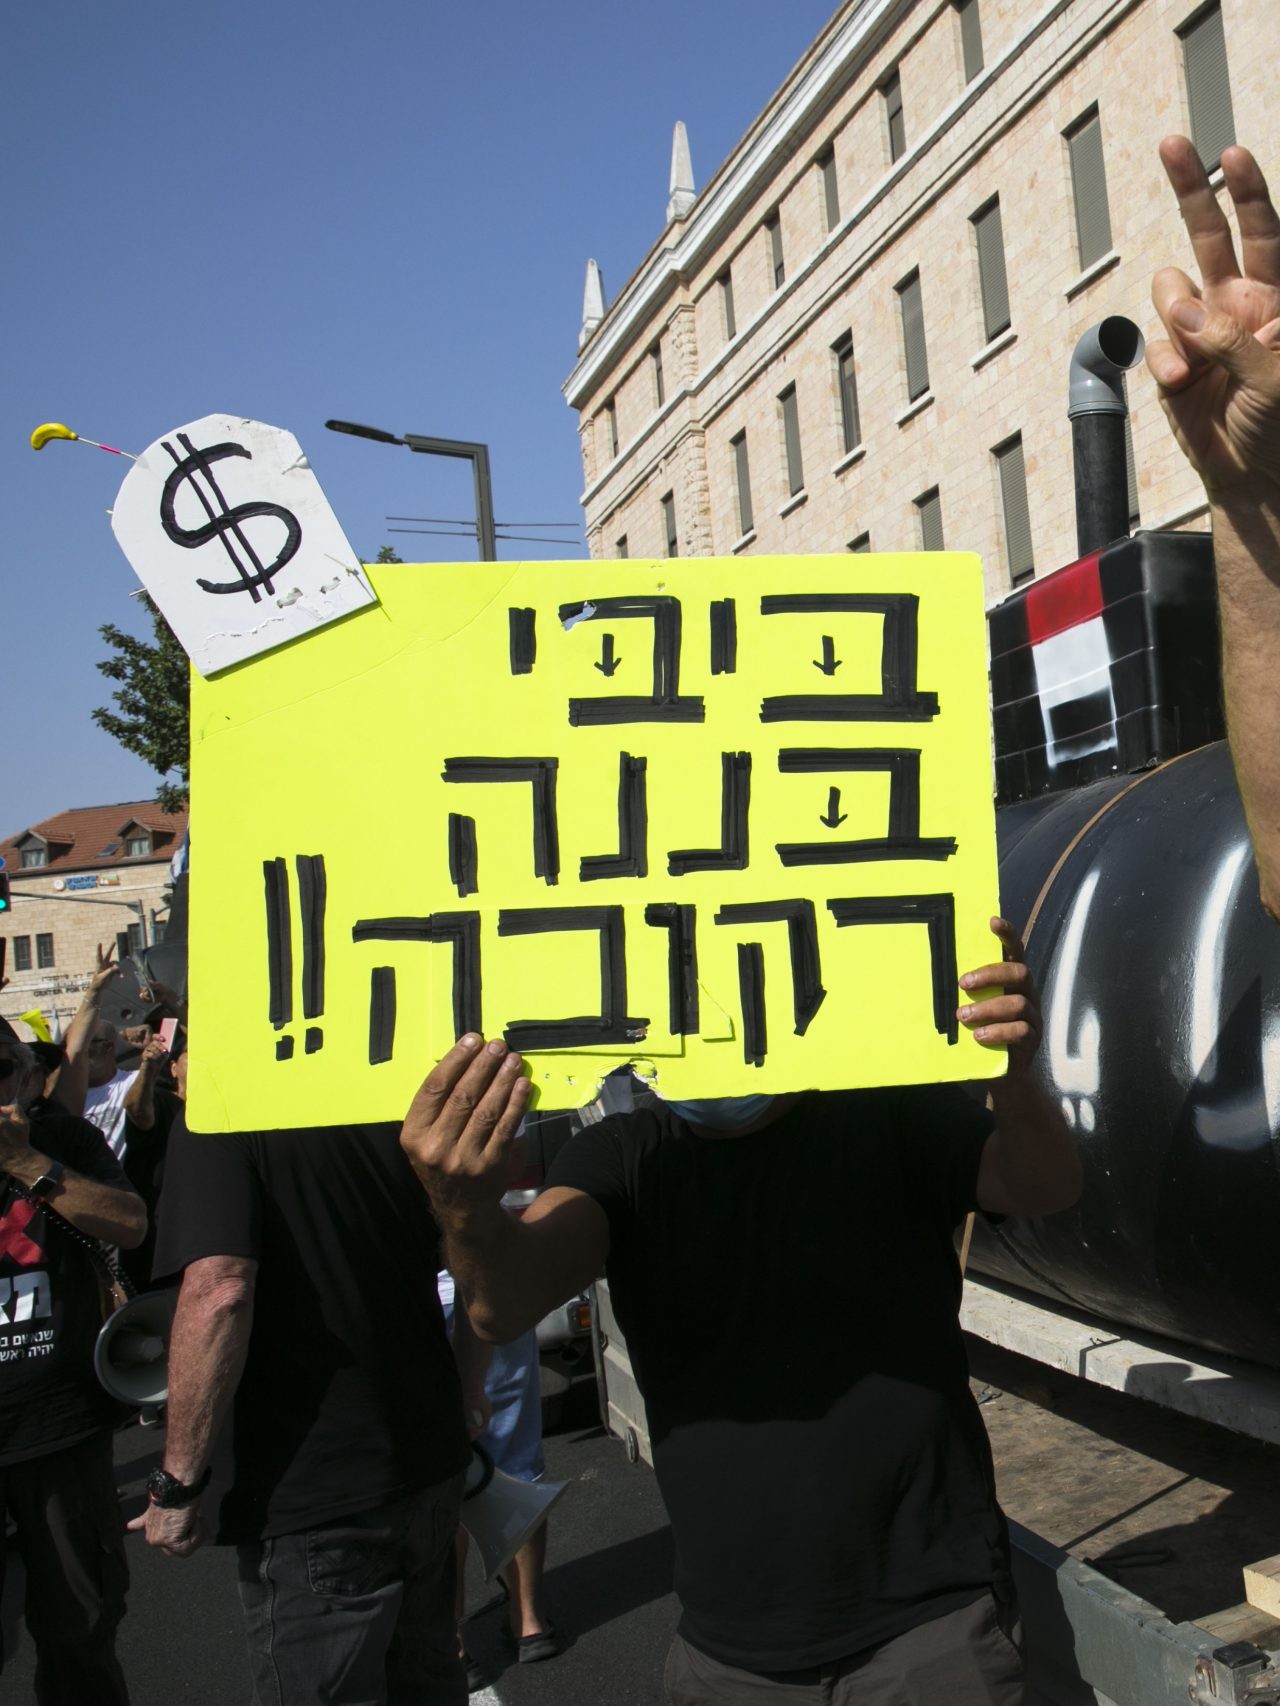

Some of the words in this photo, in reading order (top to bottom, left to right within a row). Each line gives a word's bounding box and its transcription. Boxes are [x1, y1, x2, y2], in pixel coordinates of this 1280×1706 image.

[508, 592, 941, 727] ביבי
[441, 746, 960, 898] בננה
[28, 1343, 55, 1358] יהיה
